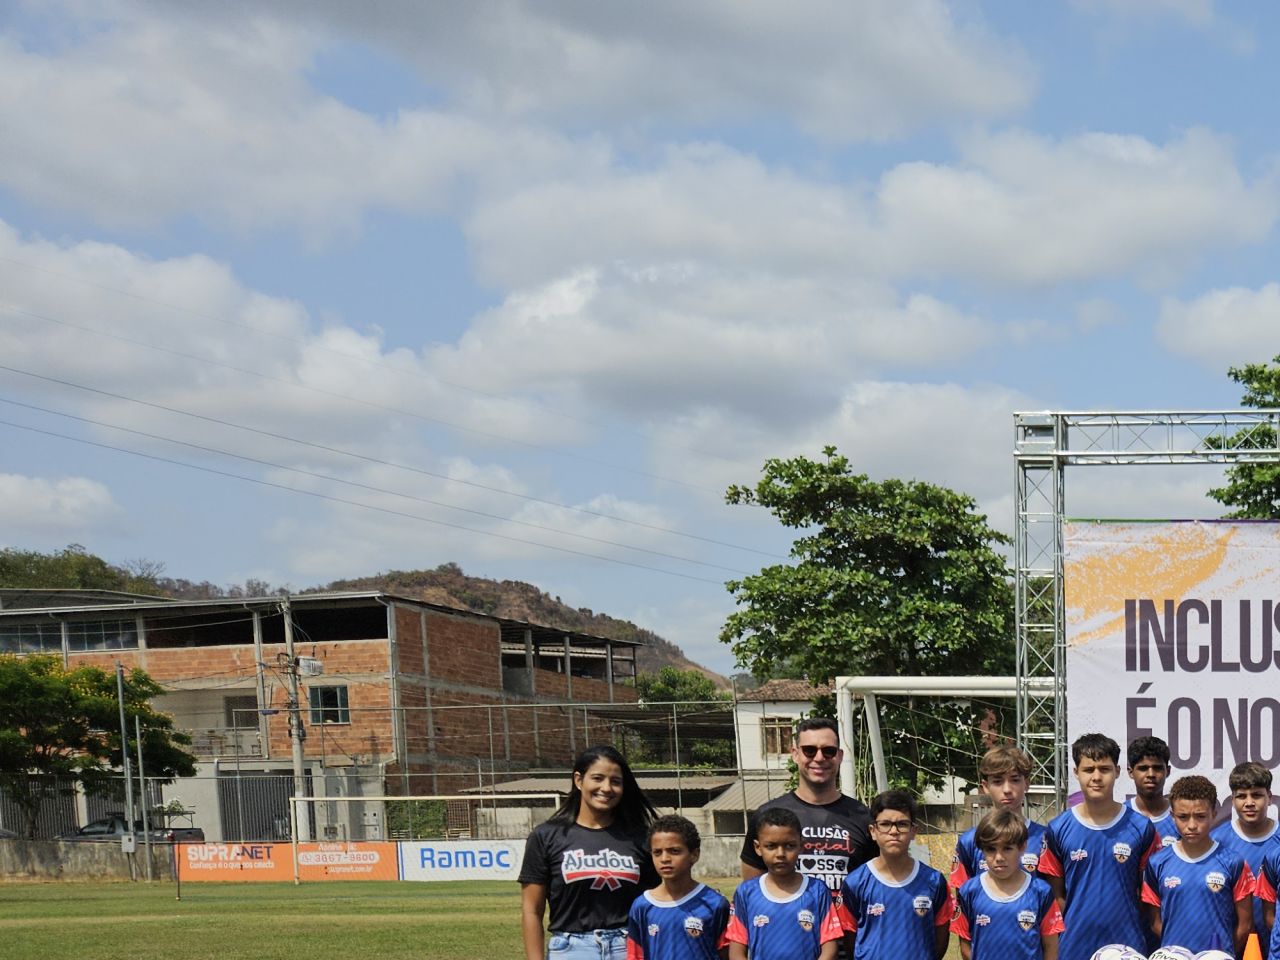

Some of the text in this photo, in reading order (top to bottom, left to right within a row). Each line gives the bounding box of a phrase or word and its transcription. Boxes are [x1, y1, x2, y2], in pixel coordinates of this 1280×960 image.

[1167, 697, 1202, 770] O
[420, 848, 510, 868] Ramac
[565, 852, 633, 870] Ajudôu
